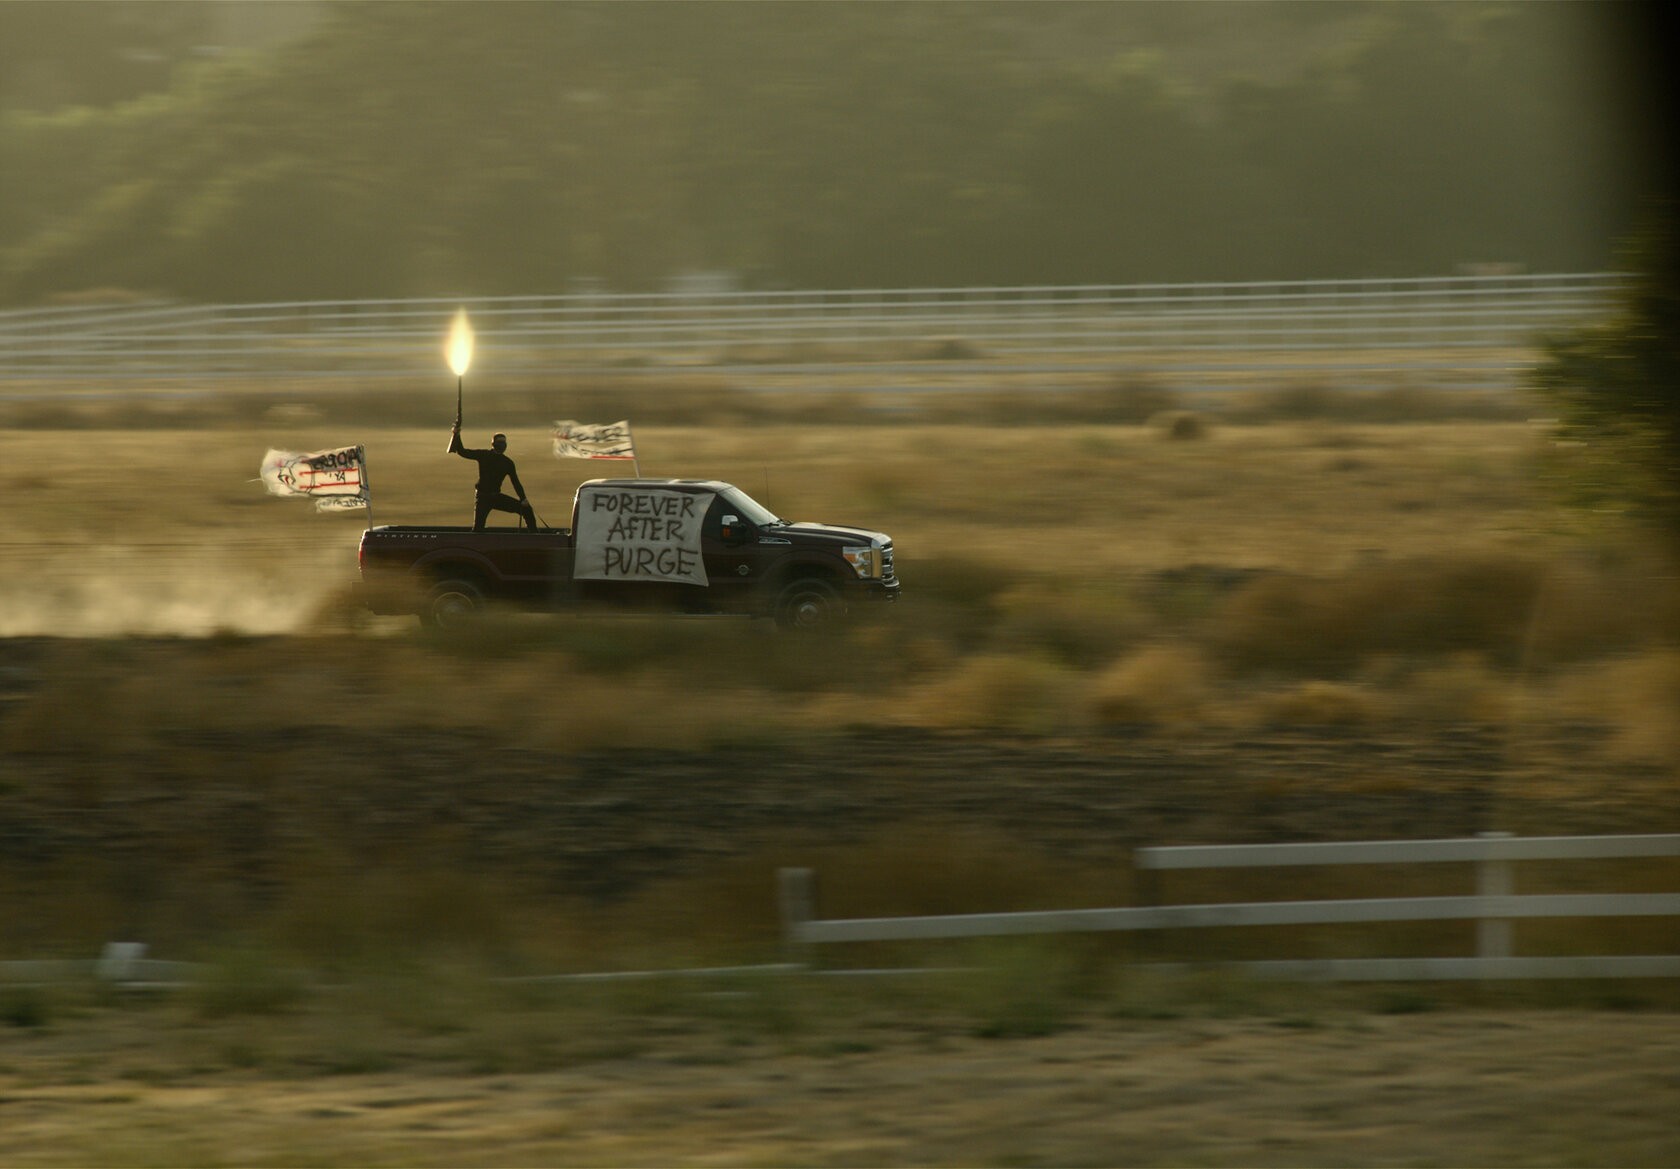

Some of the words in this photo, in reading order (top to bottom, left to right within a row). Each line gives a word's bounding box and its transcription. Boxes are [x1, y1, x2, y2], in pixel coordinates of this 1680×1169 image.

[592, 493, 694, 518] FOREVER
[607, 516, 685, 542] AFTER
[604, 547, 698, 576] PURGE
